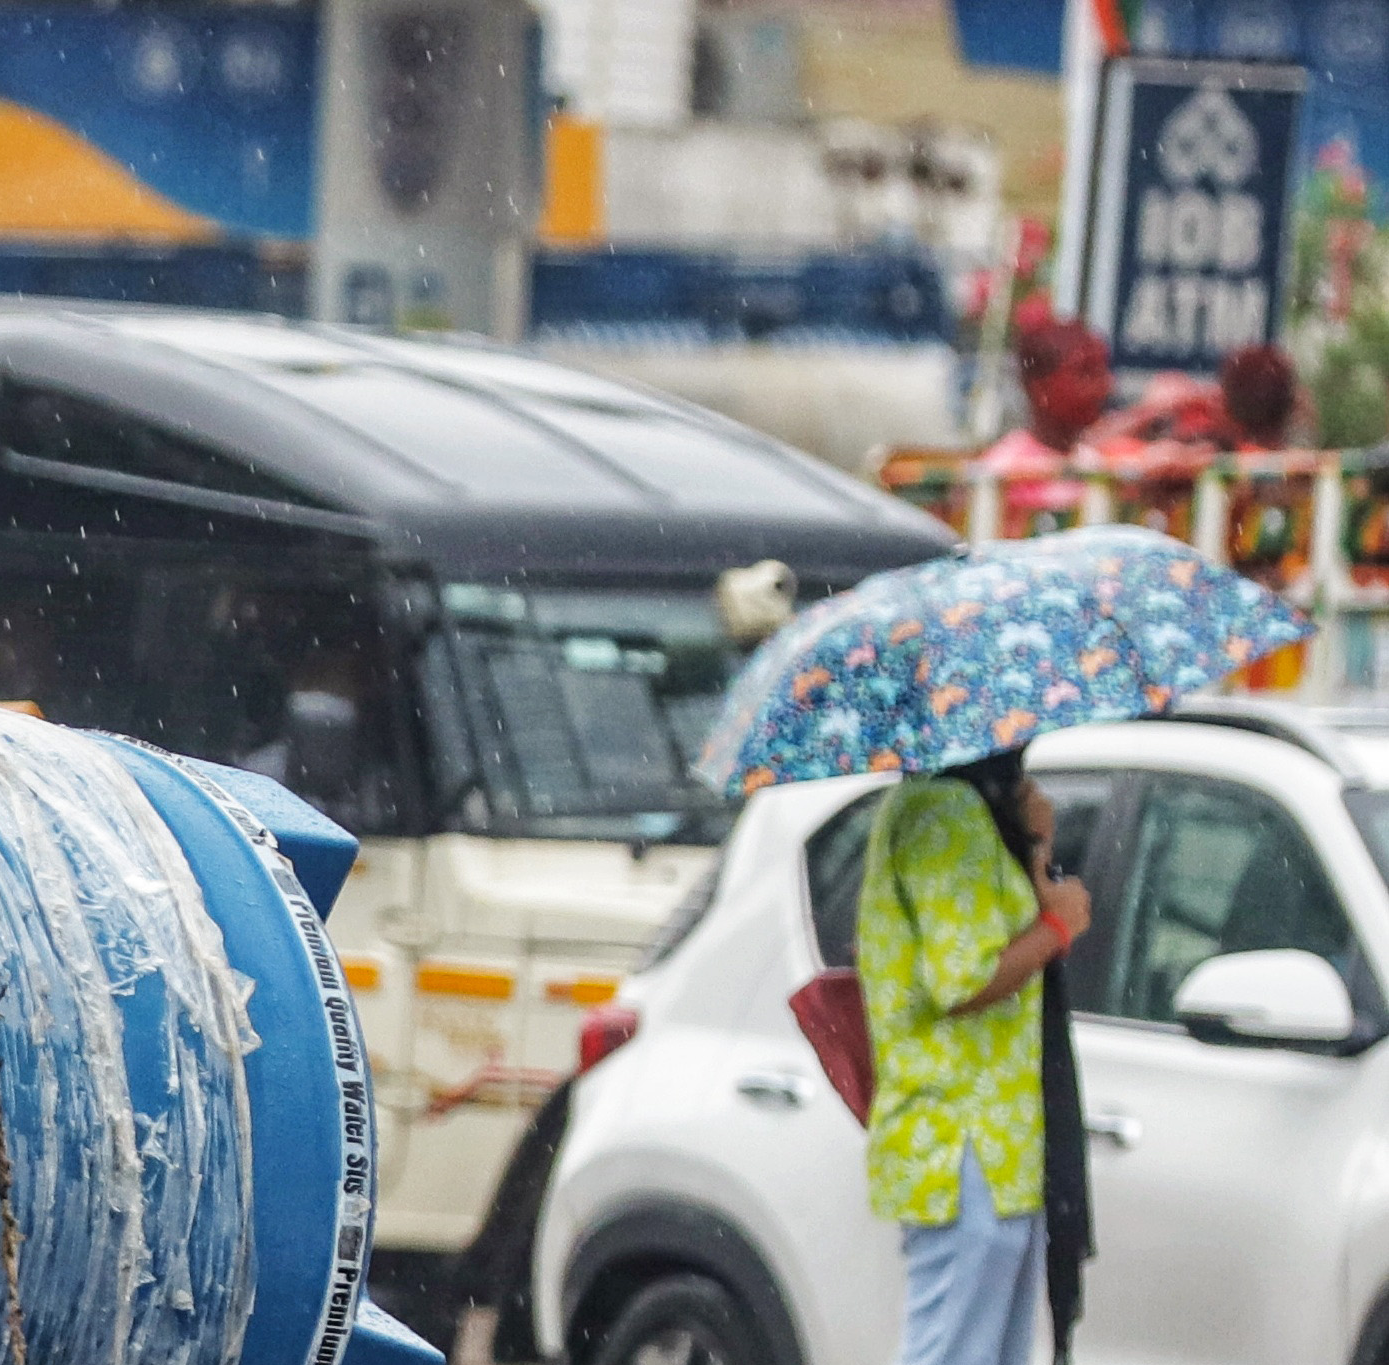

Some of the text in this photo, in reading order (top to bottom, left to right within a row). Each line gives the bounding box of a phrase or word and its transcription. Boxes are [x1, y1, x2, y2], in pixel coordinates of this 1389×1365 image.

[1125, 274, 1270, 351] ATM
[324, 996, 360, 1073] Quality
[342, 1080, 367, 1147] Water
